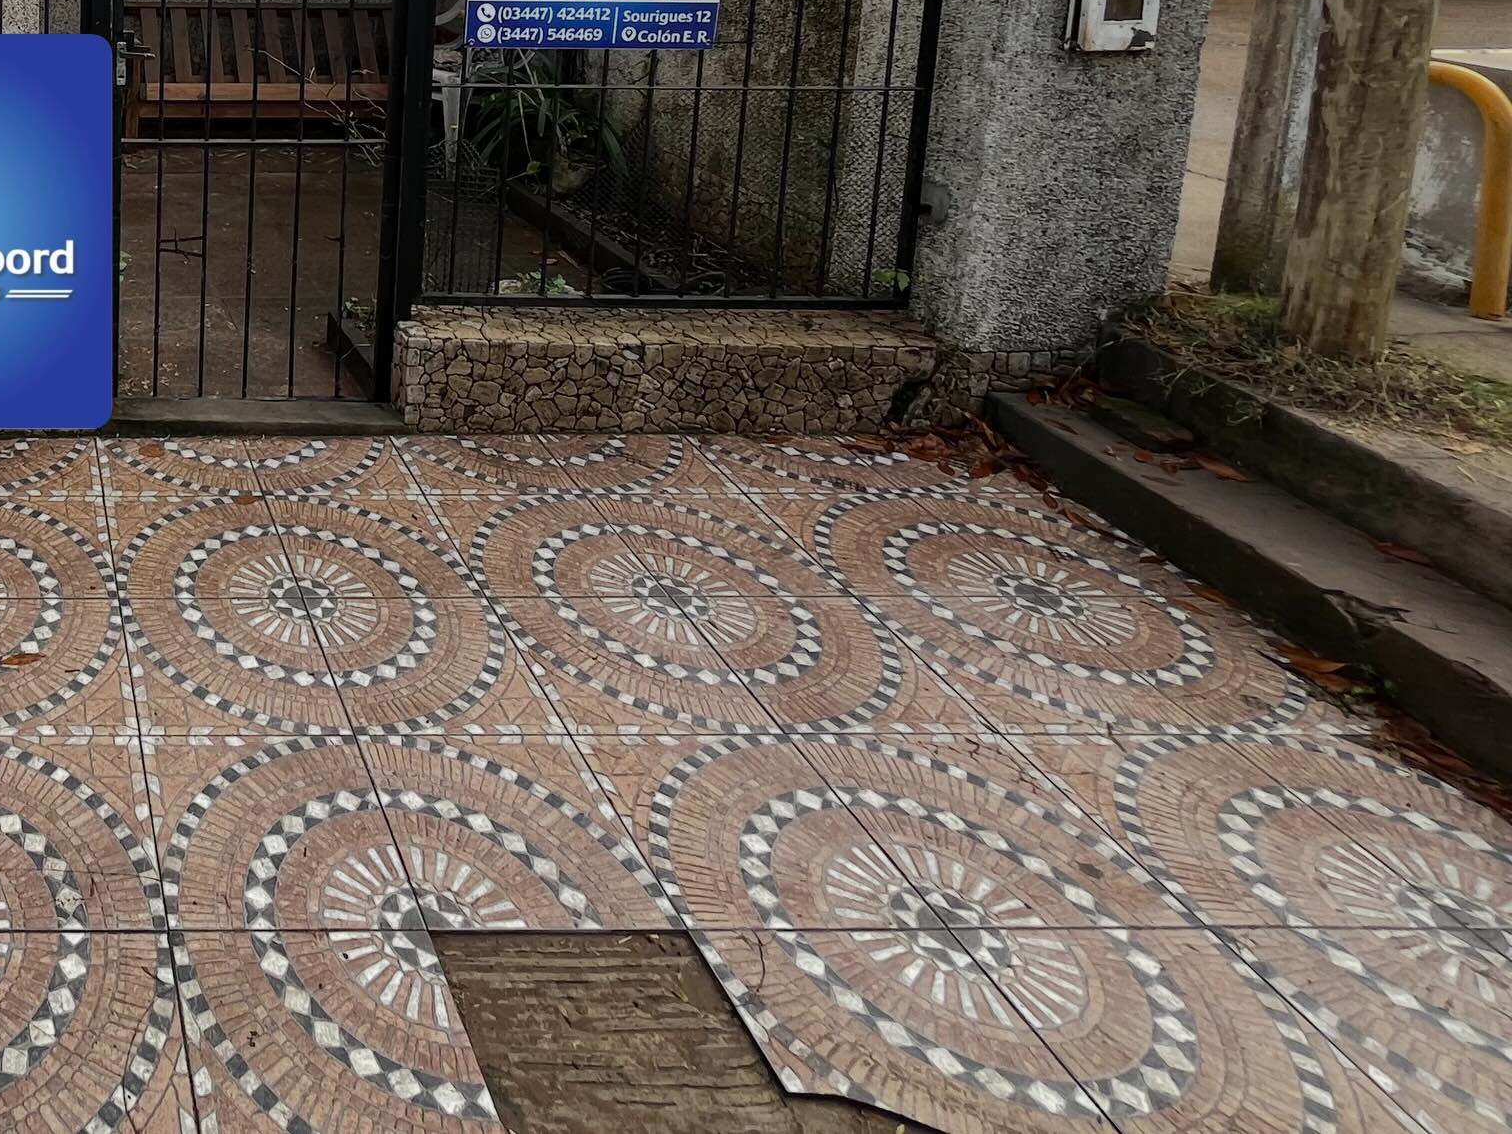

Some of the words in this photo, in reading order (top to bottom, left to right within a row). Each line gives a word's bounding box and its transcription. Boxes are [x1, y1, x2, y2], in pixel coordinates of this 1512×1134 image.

[498, 6, 553, 24] (03447)
[556, 7, 611, 21] 424412
[622, 9, 694, 26] Sourigues
[696, 10, 712, 23] 12
[497, 26, 544, 44] (3447)
[547, 28, 603, 41] 546469
[637, 29, 681, 43] Colón
